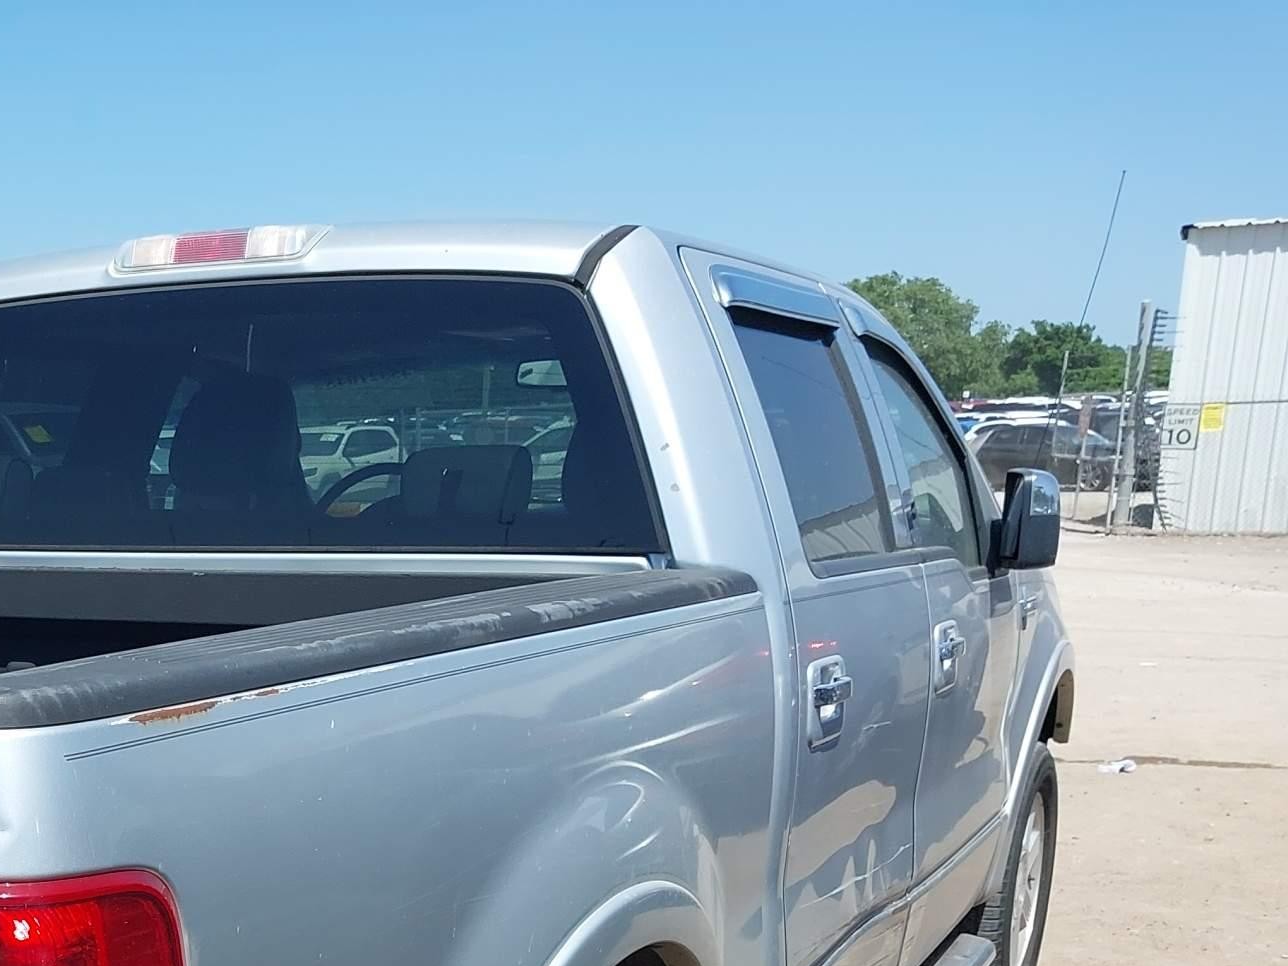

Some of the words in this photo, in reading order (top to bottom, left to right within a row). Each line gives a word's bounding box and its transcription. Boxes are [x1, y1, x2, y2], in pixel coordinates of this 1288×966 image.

[1166, 407, 1200, 416] SPEED
[1168, 417, 1194, 425] LIMIT
[1168, 428, 1192, 445] 10
